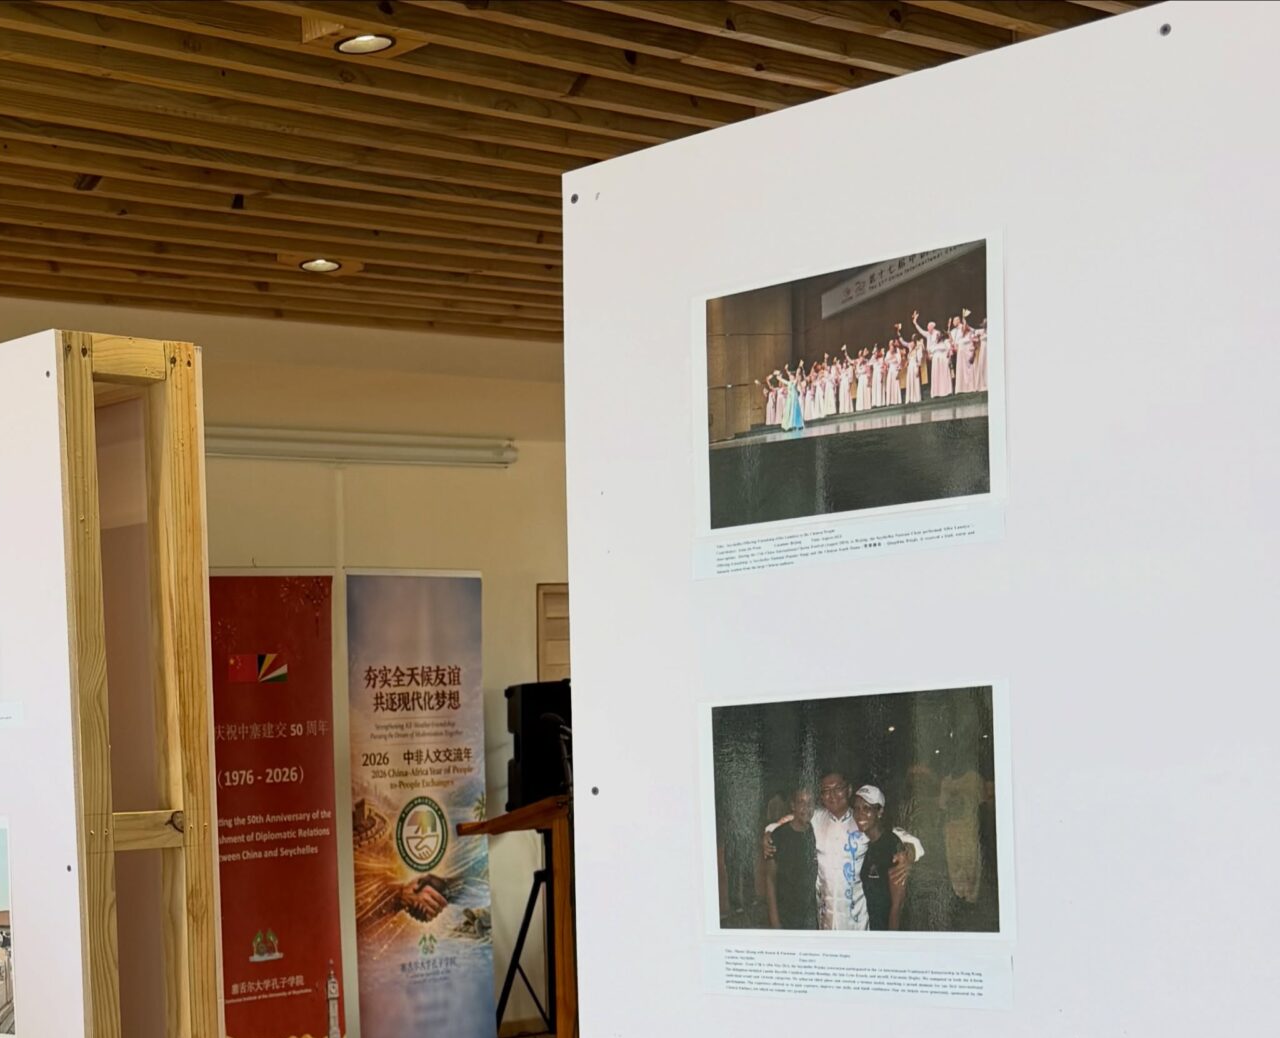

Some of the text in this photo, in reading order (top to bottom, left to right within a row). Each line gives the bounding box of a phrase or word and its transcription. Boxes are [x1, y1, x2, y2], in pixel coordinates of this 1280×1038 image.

[364, 665, 462, 688] 夯实全天候友谊
[373, 690, 461, 712] 共逐现代化梦想
[290, 723, 303, 737] 50
[306, 719, 329, 737] 周年
[362, 747, 472, 767] 2026 中非人文交流年
[234, 815, 246, 826] the
[247, 814, 264, 825] 50th
[266, 811, 311, 823] Anniversary
[312, 809, 320, 819] of
[320, 808, 332, 819] the
[246, 831, 254, 842] of
[255, 829, 297, 843] Diplomatic
[298, 827, 330, 838] Relations
[242, 849, 262, 861] China
[264, 847, 278, 857] and
[280, 844, 319, 857] Seychelles
